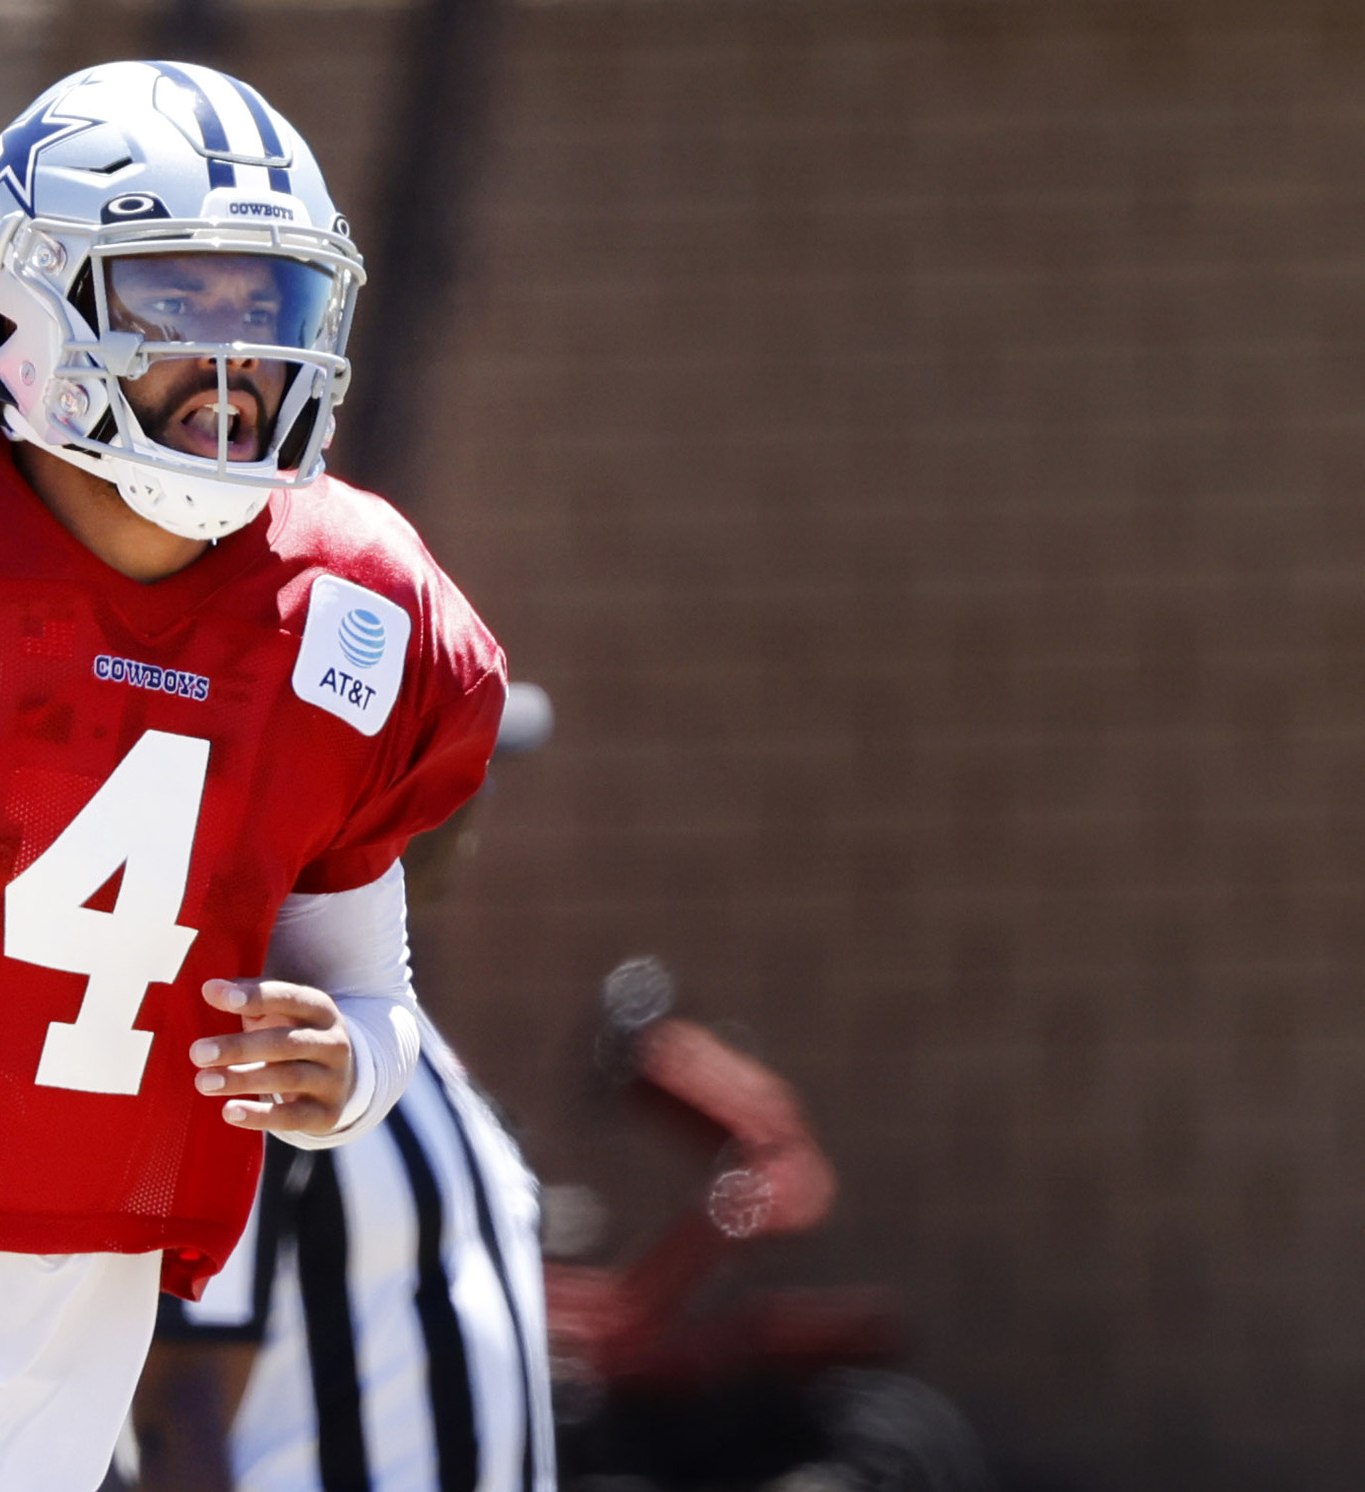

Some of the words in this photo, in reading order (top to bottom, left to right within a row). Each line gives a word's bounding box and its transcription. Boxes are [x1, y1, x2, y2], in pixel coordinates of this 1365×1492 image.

[229, 202, 294, 220] COWBOYS
[94, 655, 210, 701] COWBOYS
[319, 667, 376, 710] AT&T
[4, 728, 211, 1095] 4
